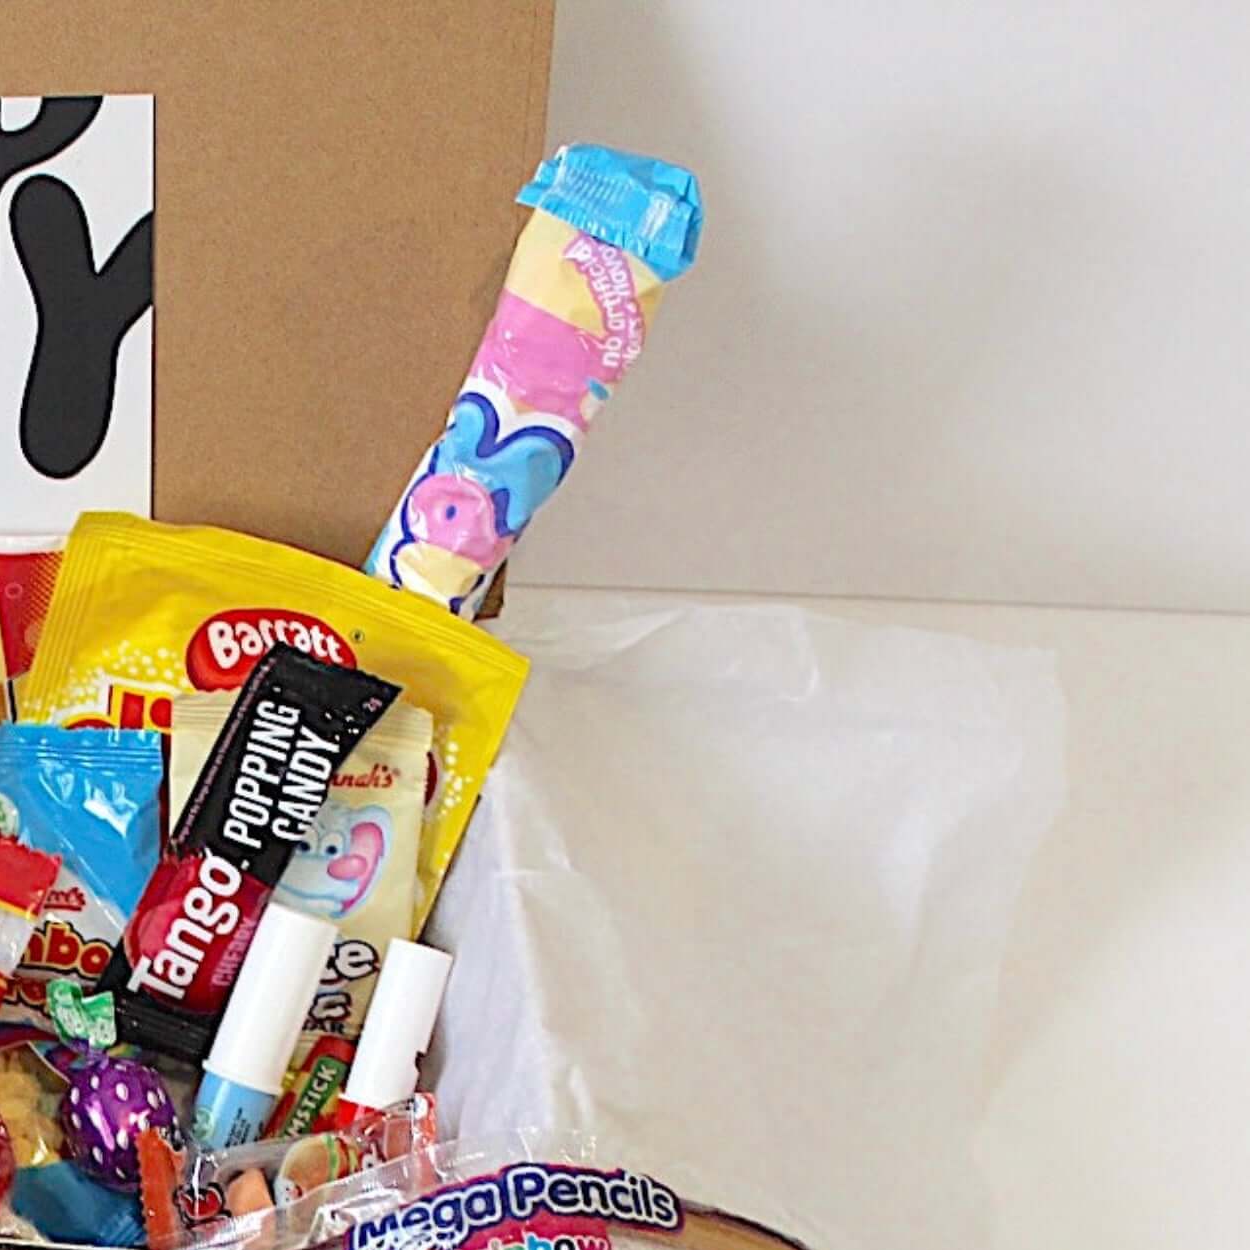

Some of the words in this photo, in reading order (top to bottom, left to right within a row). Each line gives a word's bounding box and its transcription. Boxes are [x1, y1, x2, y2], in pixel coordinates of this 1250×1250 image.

[206, 616, 345, 671] Barratt
[271, 725, 341, 842] CANDY
[126, 852, 242, 1000] Tango
[223, 699, 301, 850] POPPING
[507, 1168, 678, 1227] Pencils
